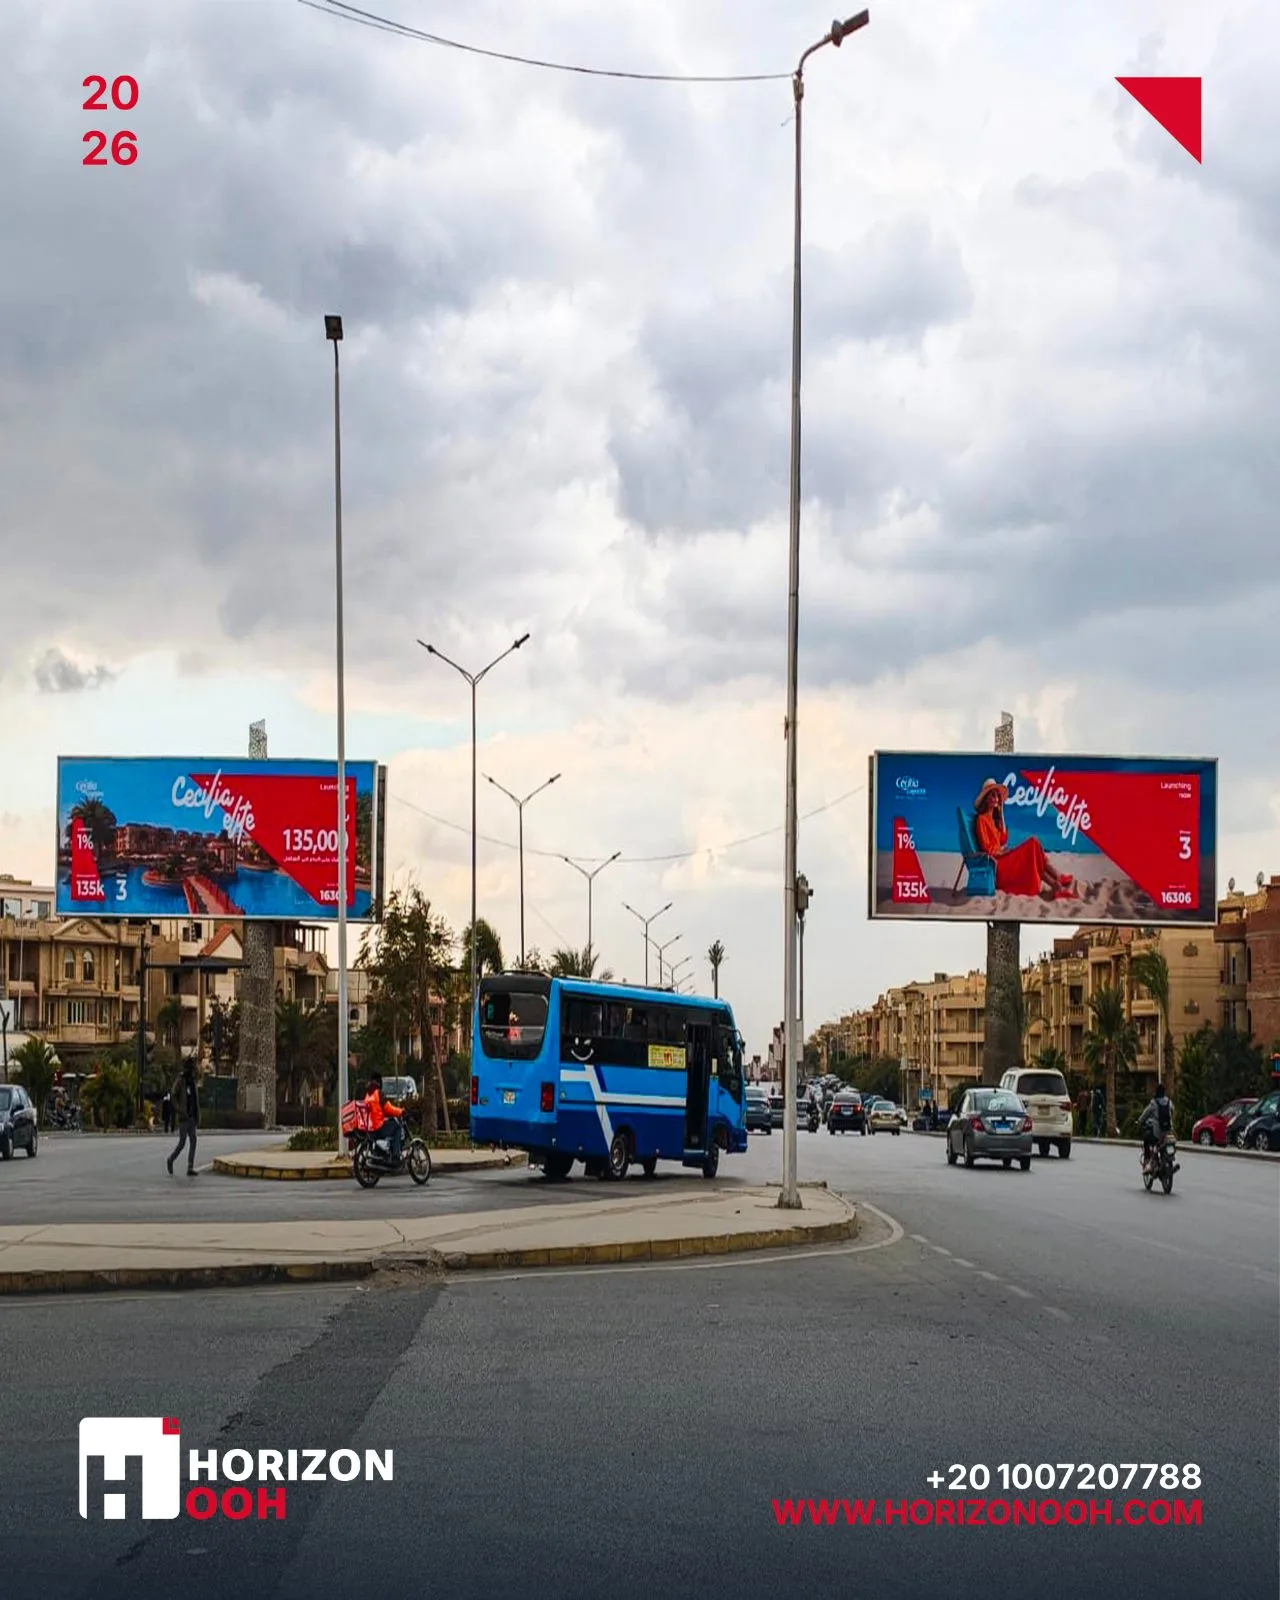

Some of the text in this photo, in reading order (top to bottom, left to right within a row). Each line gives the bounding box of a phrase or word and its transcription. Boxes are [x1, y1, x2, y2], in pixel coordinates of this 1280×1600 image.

[171, 768, 235, 818] Cecilia
[1001, 765, 1069, 817] Cecilia
[1160, 782, 1192, 791] Launching
[222, 795, 256, 845] elite
[1056, 793, 1092, 846] elite
[76, 833, 94, 850] 1%
[897, 833, 916, 850] 1%
[1178, 836, 1192, 860] 3
[76, 879, 105, 896] 135k
[115, 879, 128, 901] 3
[896, 881, 929, 898] 135k
[1161, 891, 1192, 904] 16306
